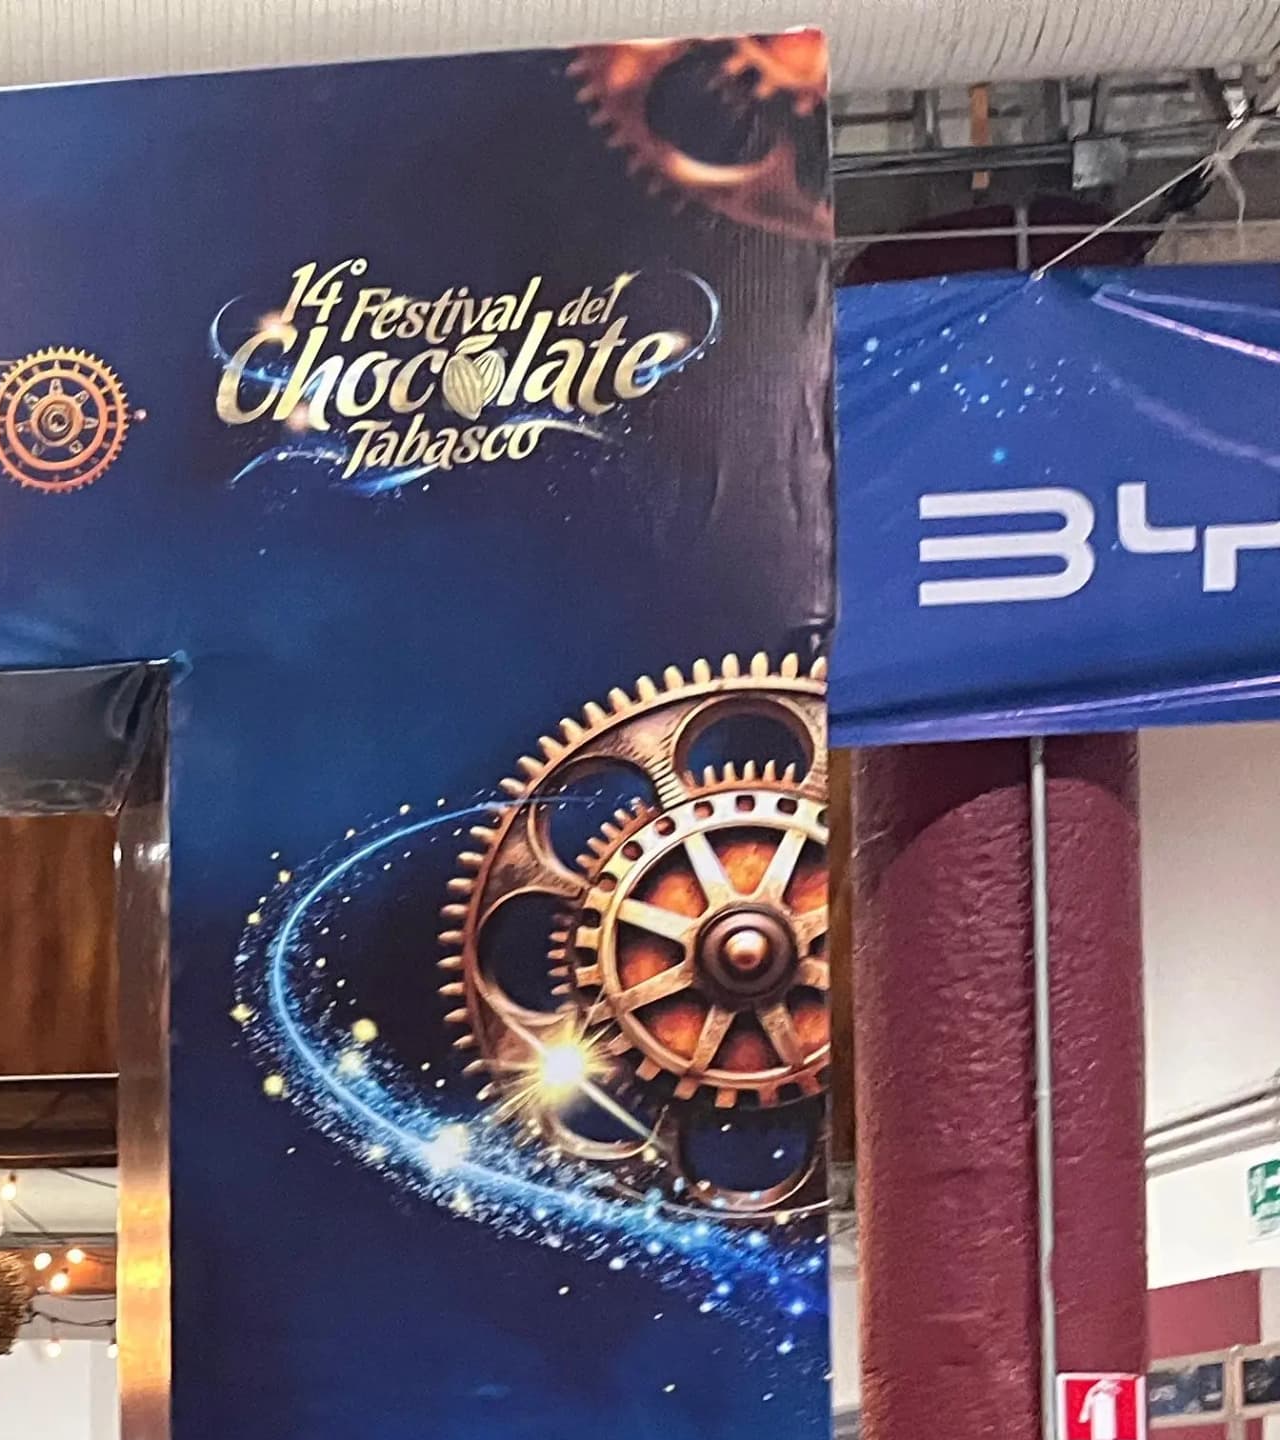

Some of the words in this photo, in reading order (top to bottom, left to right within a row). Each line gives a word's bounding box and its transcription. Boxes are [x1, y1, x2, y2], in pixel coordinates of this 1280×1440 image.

[339, 275, 543, 343] Festival
[556, 276, 630, 328] del
[341, 418, 544, 481] Tabasco
